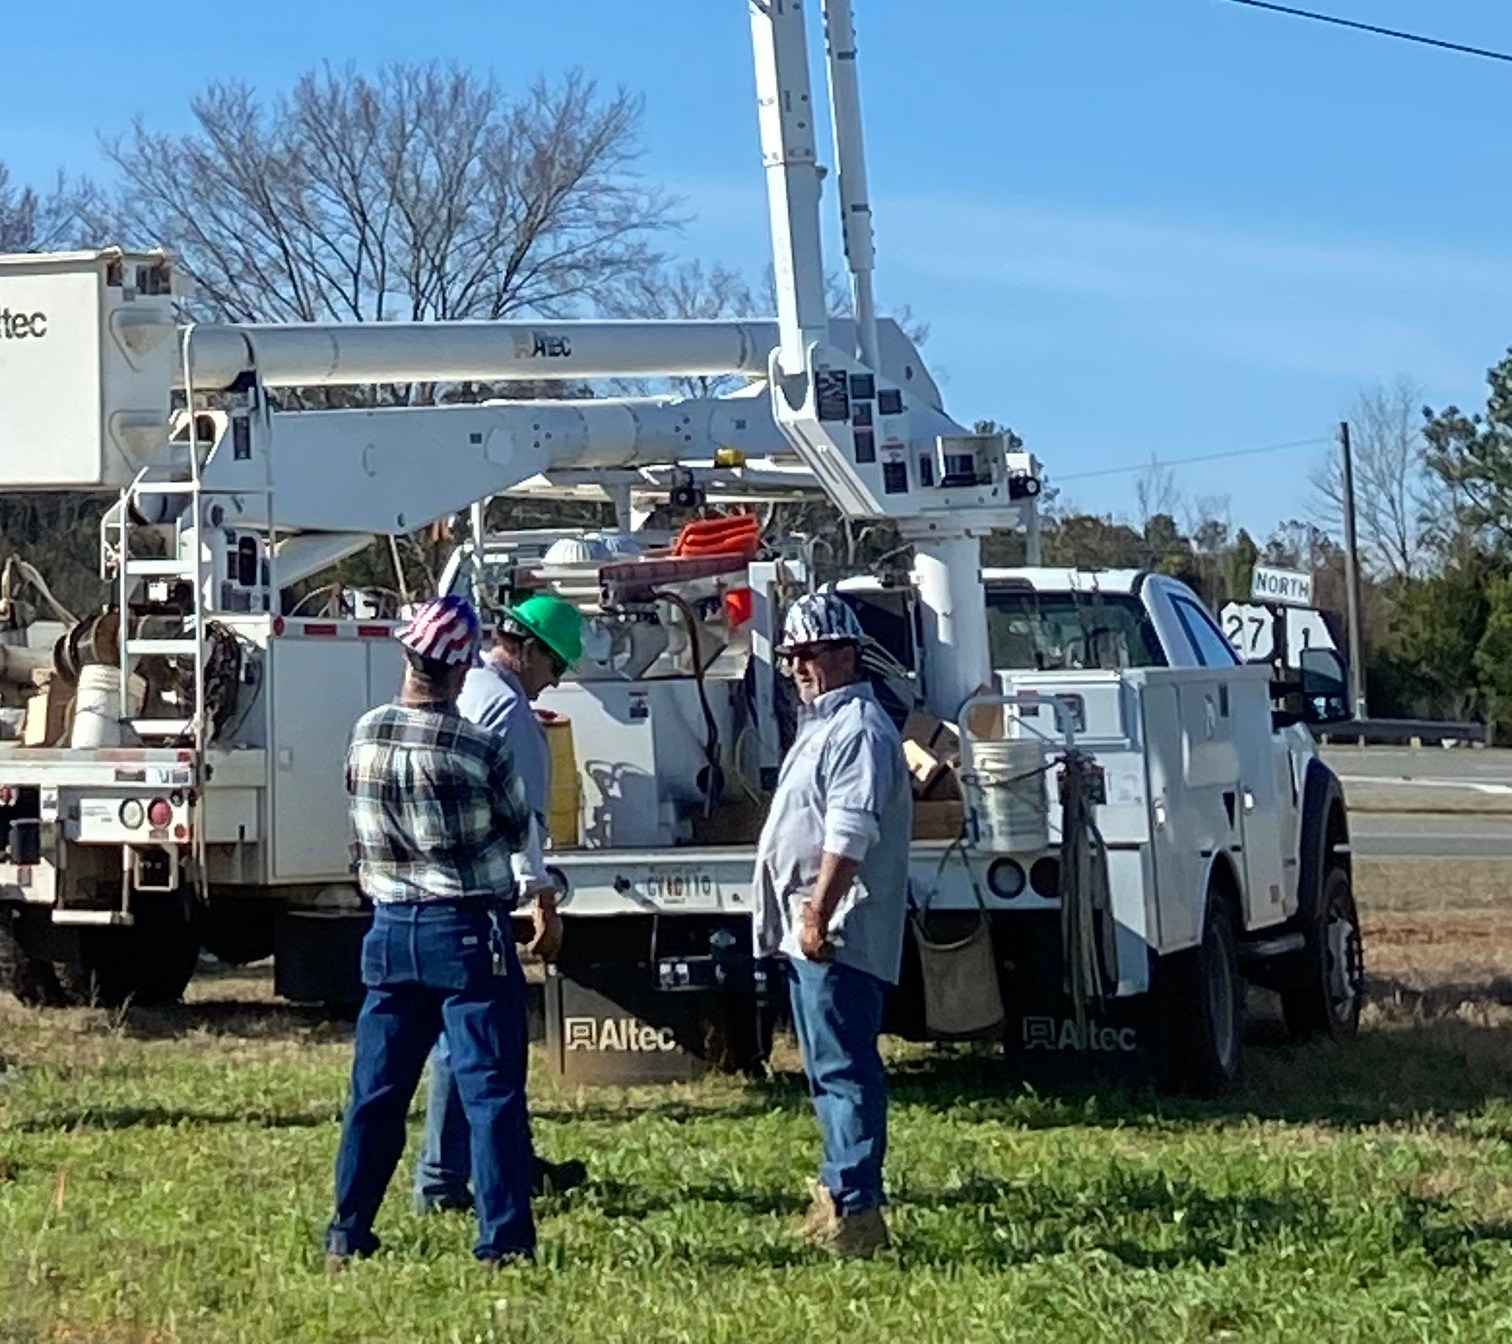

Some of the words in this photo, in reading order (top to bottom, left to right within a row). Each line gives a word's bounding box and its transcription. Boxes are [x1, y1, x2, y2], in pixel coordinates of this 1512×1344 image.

[1256, 572, 1309, 598] NORTH
[1227, 615, 1265, 652] 27
[599, 1017, 676, 1052] Altec
[1058, 1018, 1136, 1052] Altec
